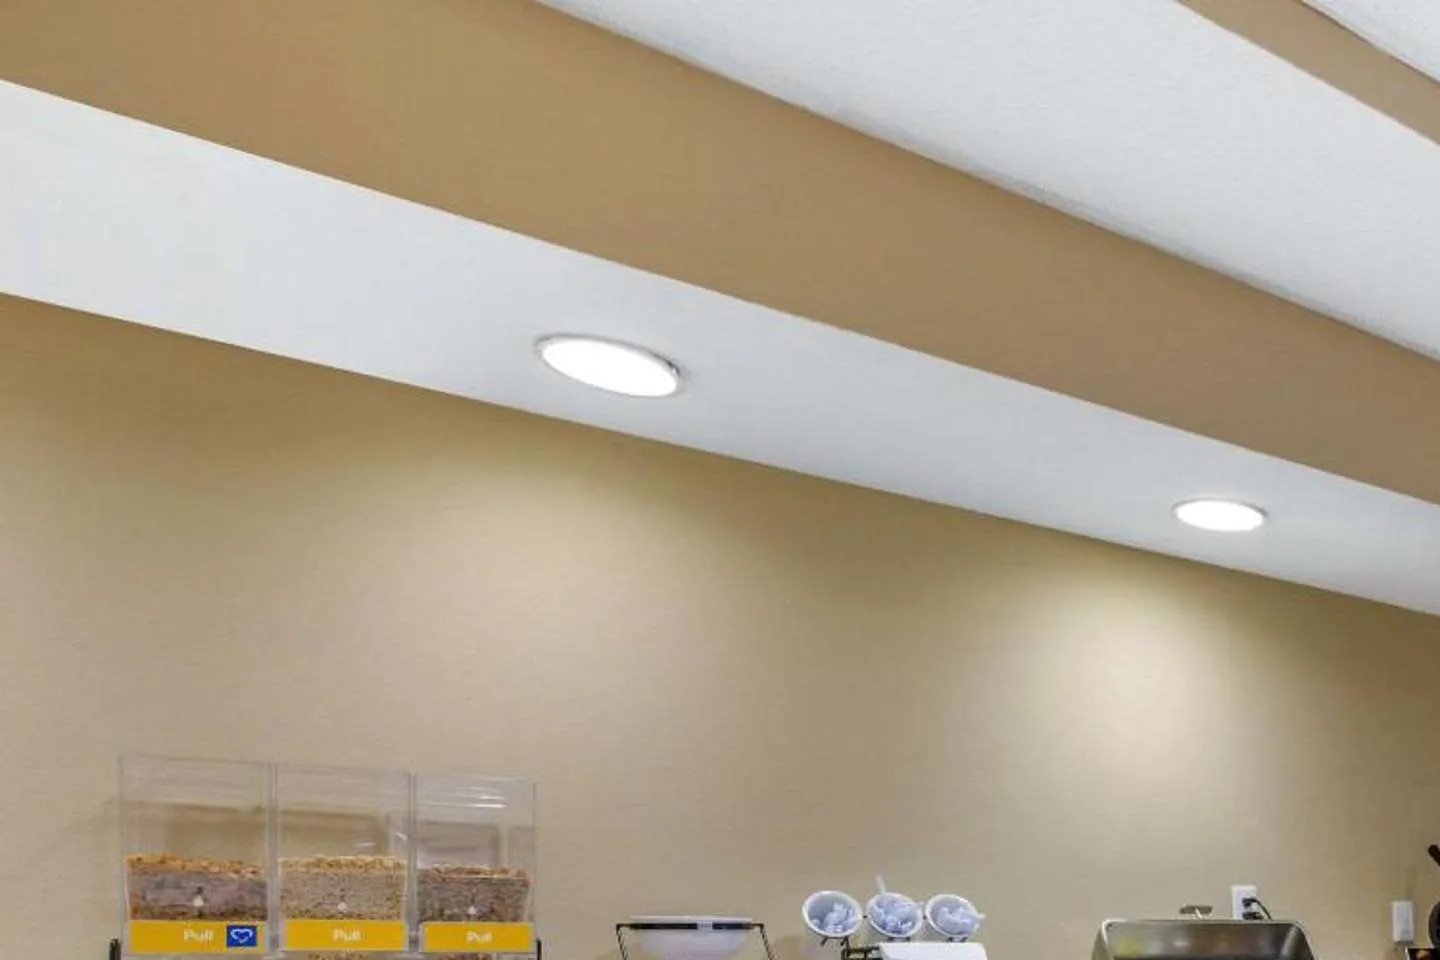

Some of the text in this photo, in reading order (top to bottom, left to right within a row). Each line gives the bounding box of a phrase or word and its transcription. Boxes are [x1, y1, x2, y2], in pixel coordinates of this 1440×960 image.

[183, 929, 213, 942] Pull
[332, 927, 361, 941] Pull
[466, 931, 493, 944] Pull
